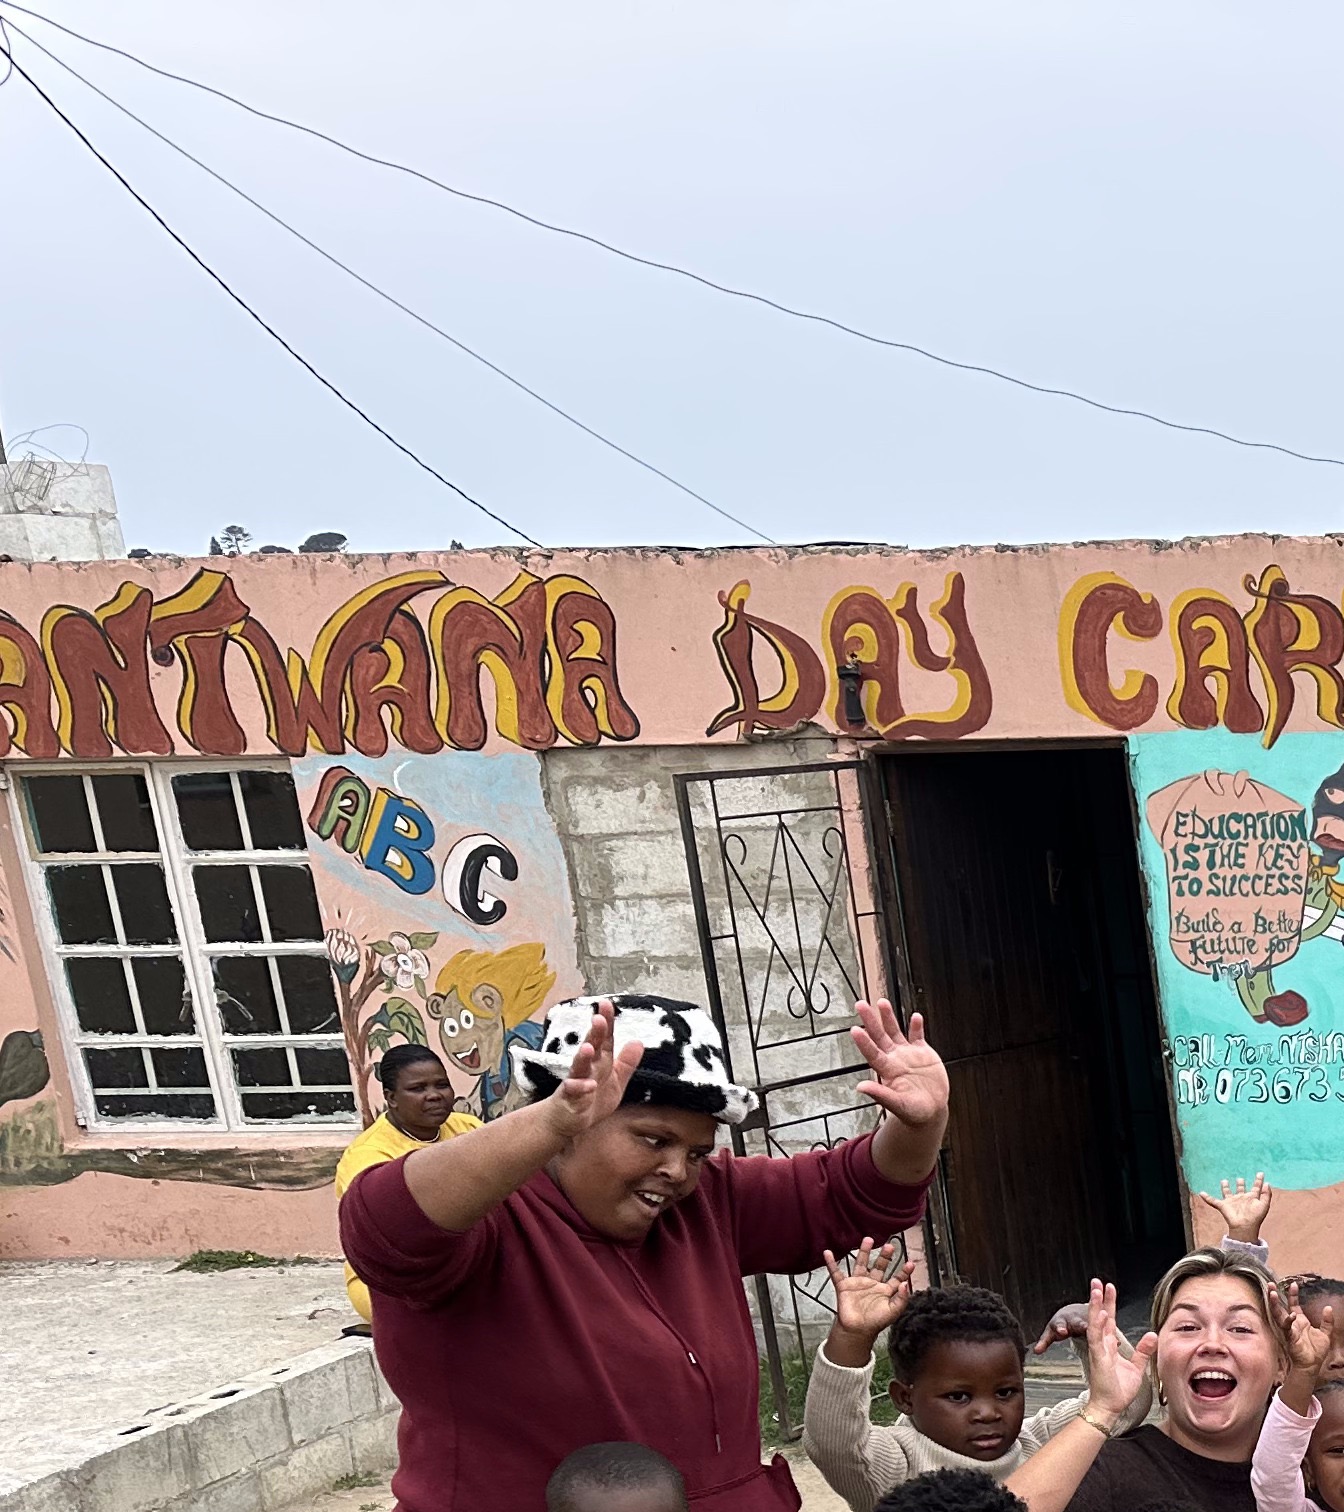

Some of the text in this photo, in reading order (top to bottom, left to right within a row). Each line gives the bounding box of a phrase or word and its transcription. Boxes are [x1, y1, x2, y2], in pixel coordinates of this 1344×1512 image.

[705, 571, 992, 741] DAY
[1173, 804, 1307, 843] EDUCATION
[1169, 840, 1305, 873] IS THE KEY
[1171, 872, 1303, 897] TO SUCCESS
[1228, 920, 1244, 934] a
